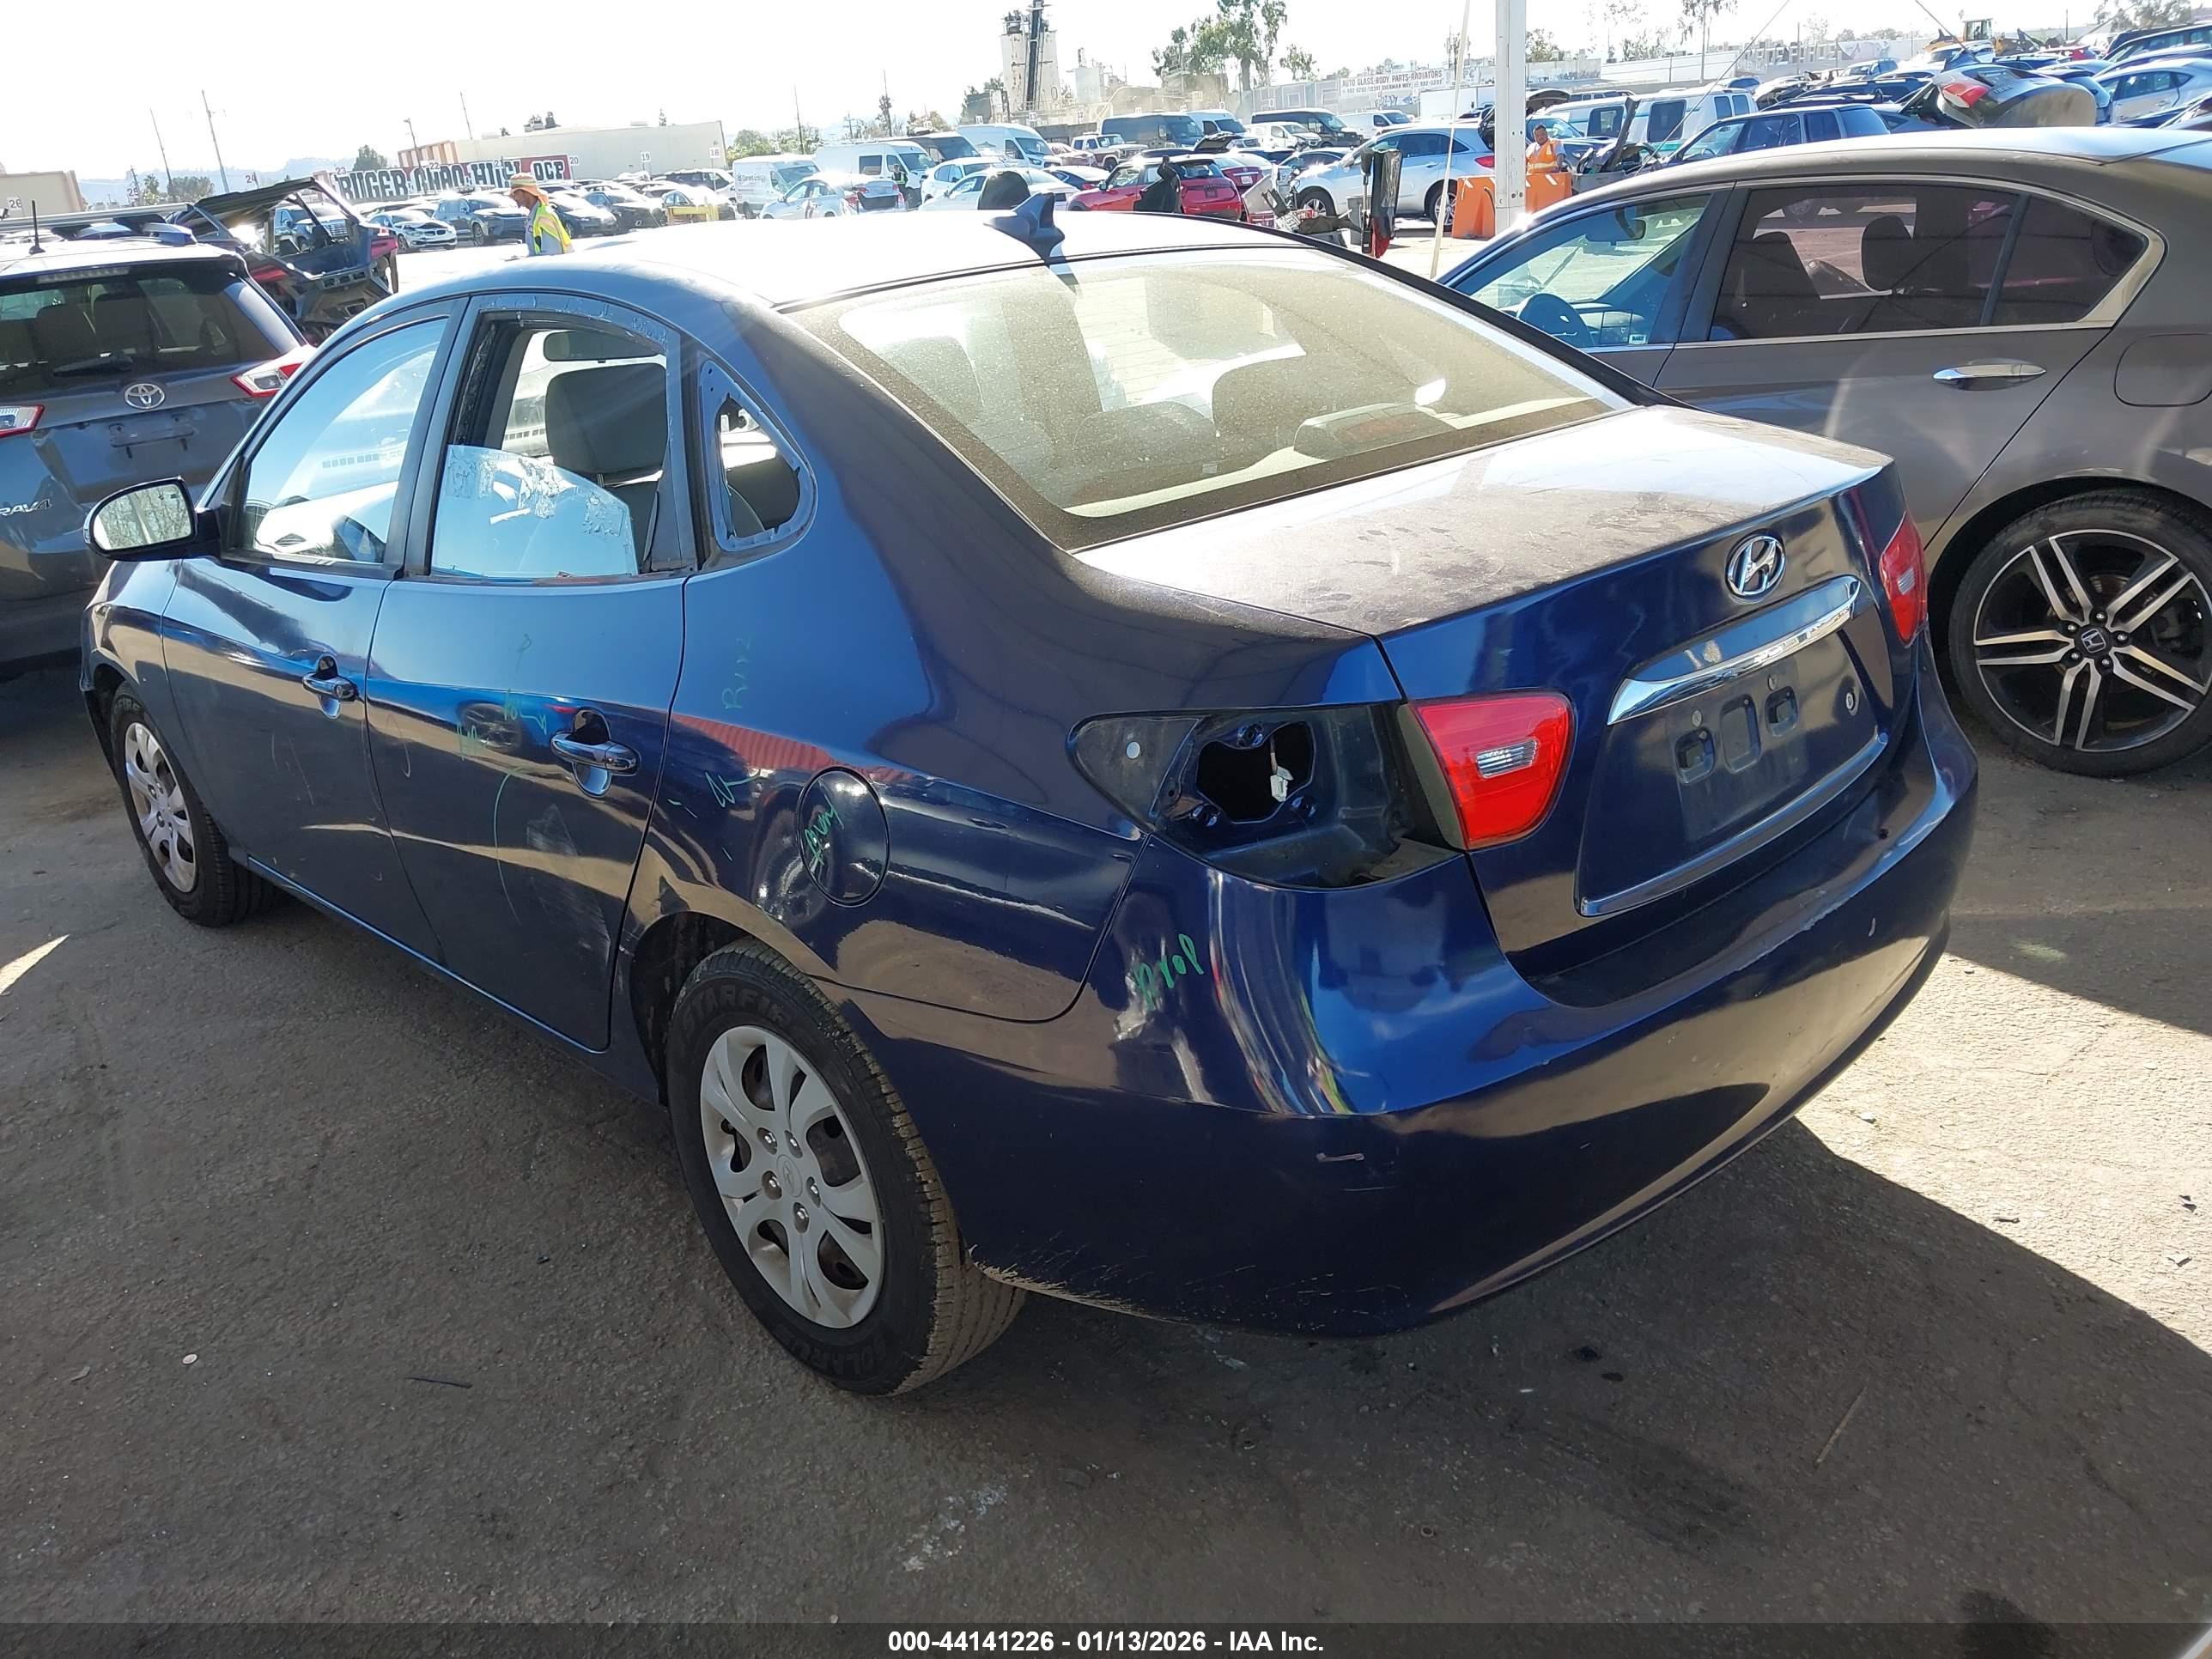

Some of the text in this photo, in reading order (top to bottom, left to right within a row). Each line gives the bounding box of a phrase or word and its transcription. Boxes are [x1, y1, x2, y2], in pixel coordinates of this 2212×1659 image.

[569, 156, 579, 165] 20
[429, 161, 440, 170] 22
[335, 167, 347, 175] 23
[245, 174, 258, 184] 24
[0, 498, 52, 516] RAV4
